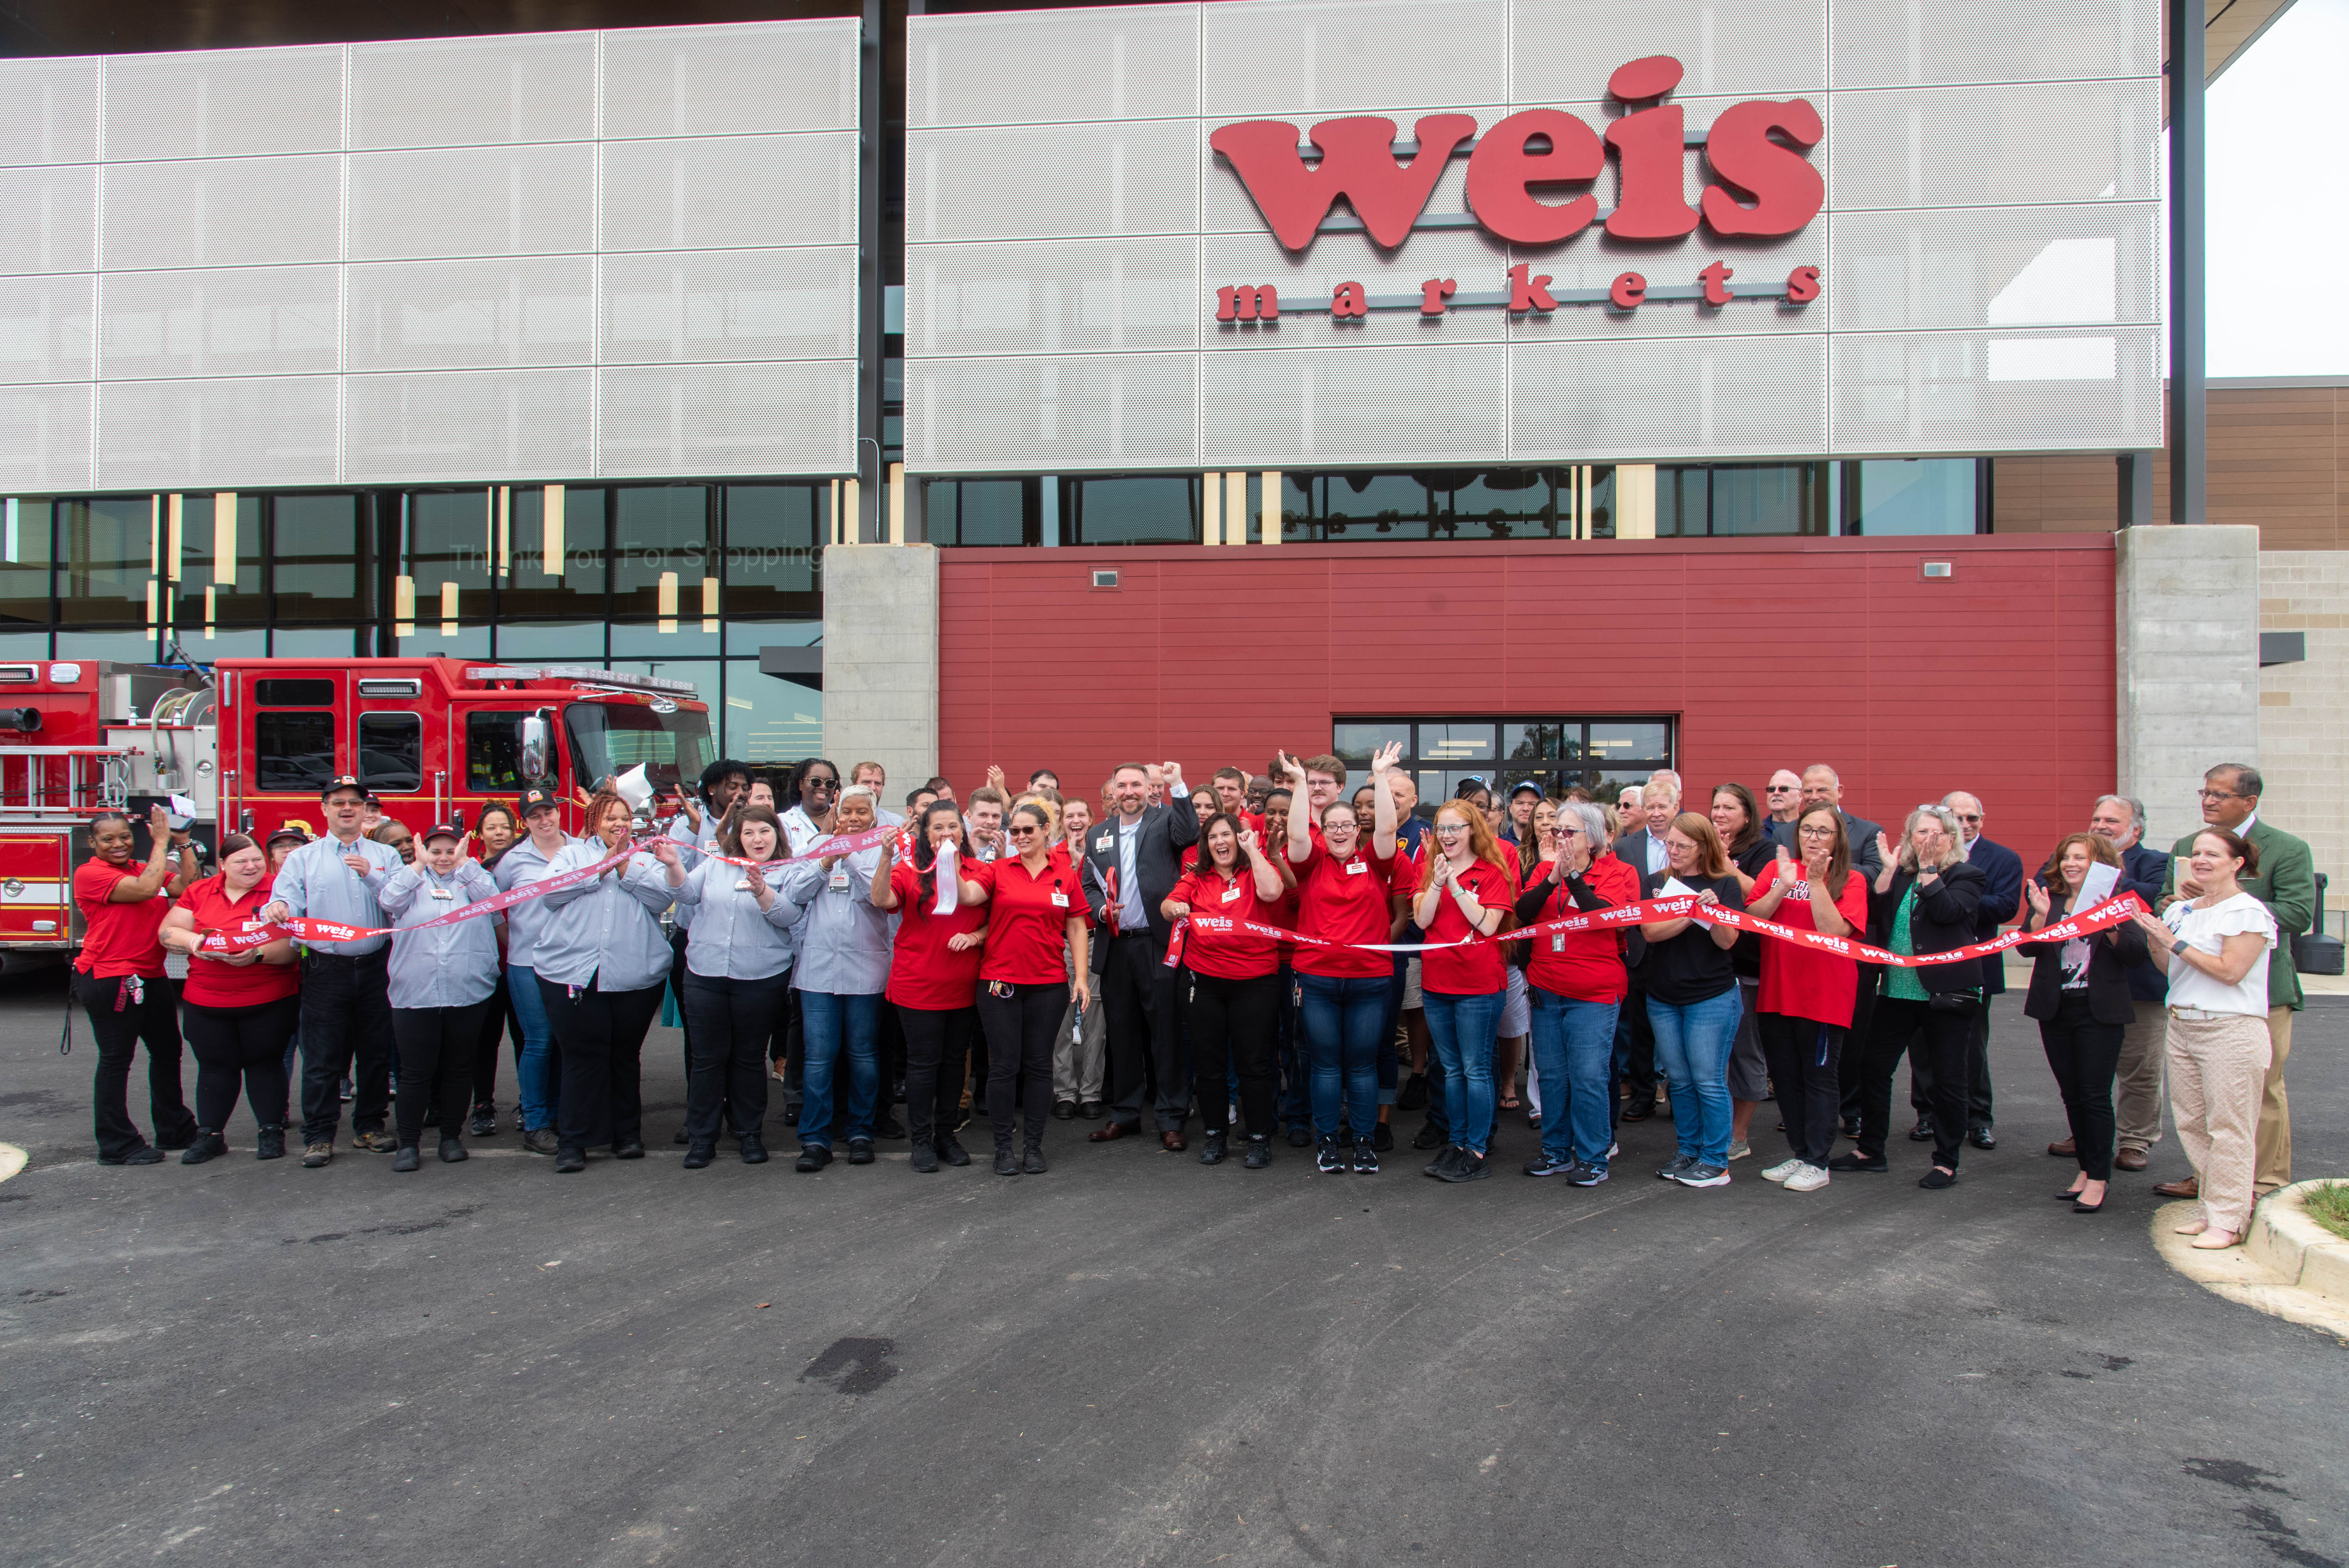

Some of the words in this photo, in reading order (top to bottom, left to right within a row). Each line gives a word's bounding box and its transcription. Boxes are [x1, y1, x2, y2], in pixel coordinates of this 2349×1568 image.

[1209, 55, 1825, 251] weis
[1216, 260, 1821, 321] markets
[449, 543, 542, 570] Thnk
[625, 541, 674, 568] For
[1652, 897, 1693, 913] weis
[2087, 898, 2132, 922] weis
[1599, 905, 1641, 921] weis
[1701, 904, 1740, 923] weis
[1195, 916, 1233, 928] weis
[1244, 922, 1281, 937] weis
[1547, 916, 1588, 930] weis
[1752, 919, 1794, 937] weis
[232, 931, 269, 944] weis
[316, 924, 355, 937] weis
[1497, 927, 1536, 940] weis
[1773, 932, 1794, 940] markets
[2031, 923, 2078, 940] weis
[2058, 930, 2081, 939] markets
[205, 934, 226, 946] weis
[1805, 934, 1849, 950] weis
[1975, 931, 2020, 951] weis
[1827, 946, 1849, 954] markets
[1860, 948, 1904, 963] weis
[1916, 951, 1964, 961] weis
